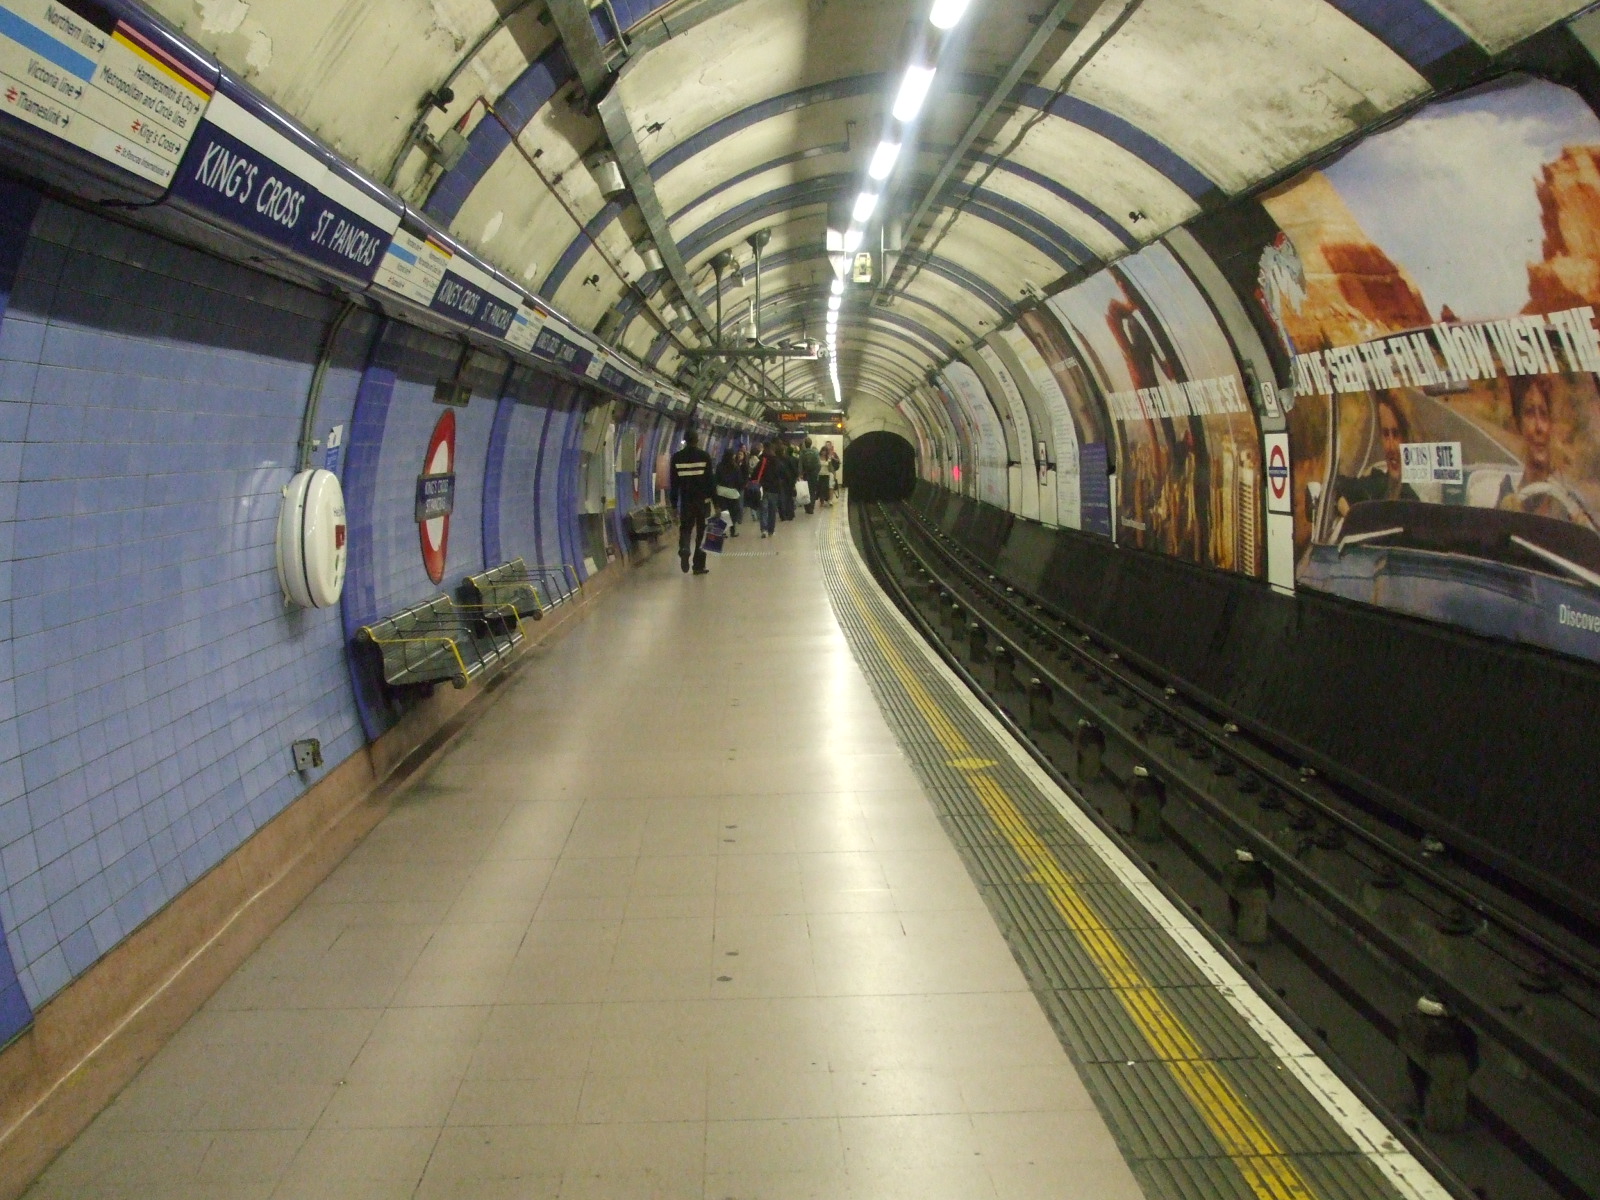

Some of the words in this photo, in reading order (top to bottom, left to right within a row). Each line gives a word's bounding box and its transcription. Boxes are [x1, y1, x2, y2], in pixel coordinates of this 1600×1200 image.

[44, 4, 82, 40] Northern
[81, 29, 97, 49] line
[27, 58, 60, 89] Victoria
[58, 77, 74, 97] line
[100, 65, 144, 101] Metropolitan
[142, 94, 156, 109] and
[154, 100, 173, 120] Circle
[172, 111, 187, 128] lines
[134, 64, 177, 101] Hammersmith
[181, 95, 195, 115] City
[158, 134, 177, 153] Cross
[195, 141, 259, 204] KING'S
[256, 176, 305, 229] CROSS
[311, 209, 335, 246] ST.
[328, 219, 381, 267] PANCRAS
[1324, 344, 1371, 394] SEEN
[1359, 340, 1401, 390] THE
[1431, 322, 1497, 382] NOW
[1485, 314, 1560, 376] VISIT
[1548, 306, 1600, 373] THE
[1436, 445, 1454, 467] SITE
